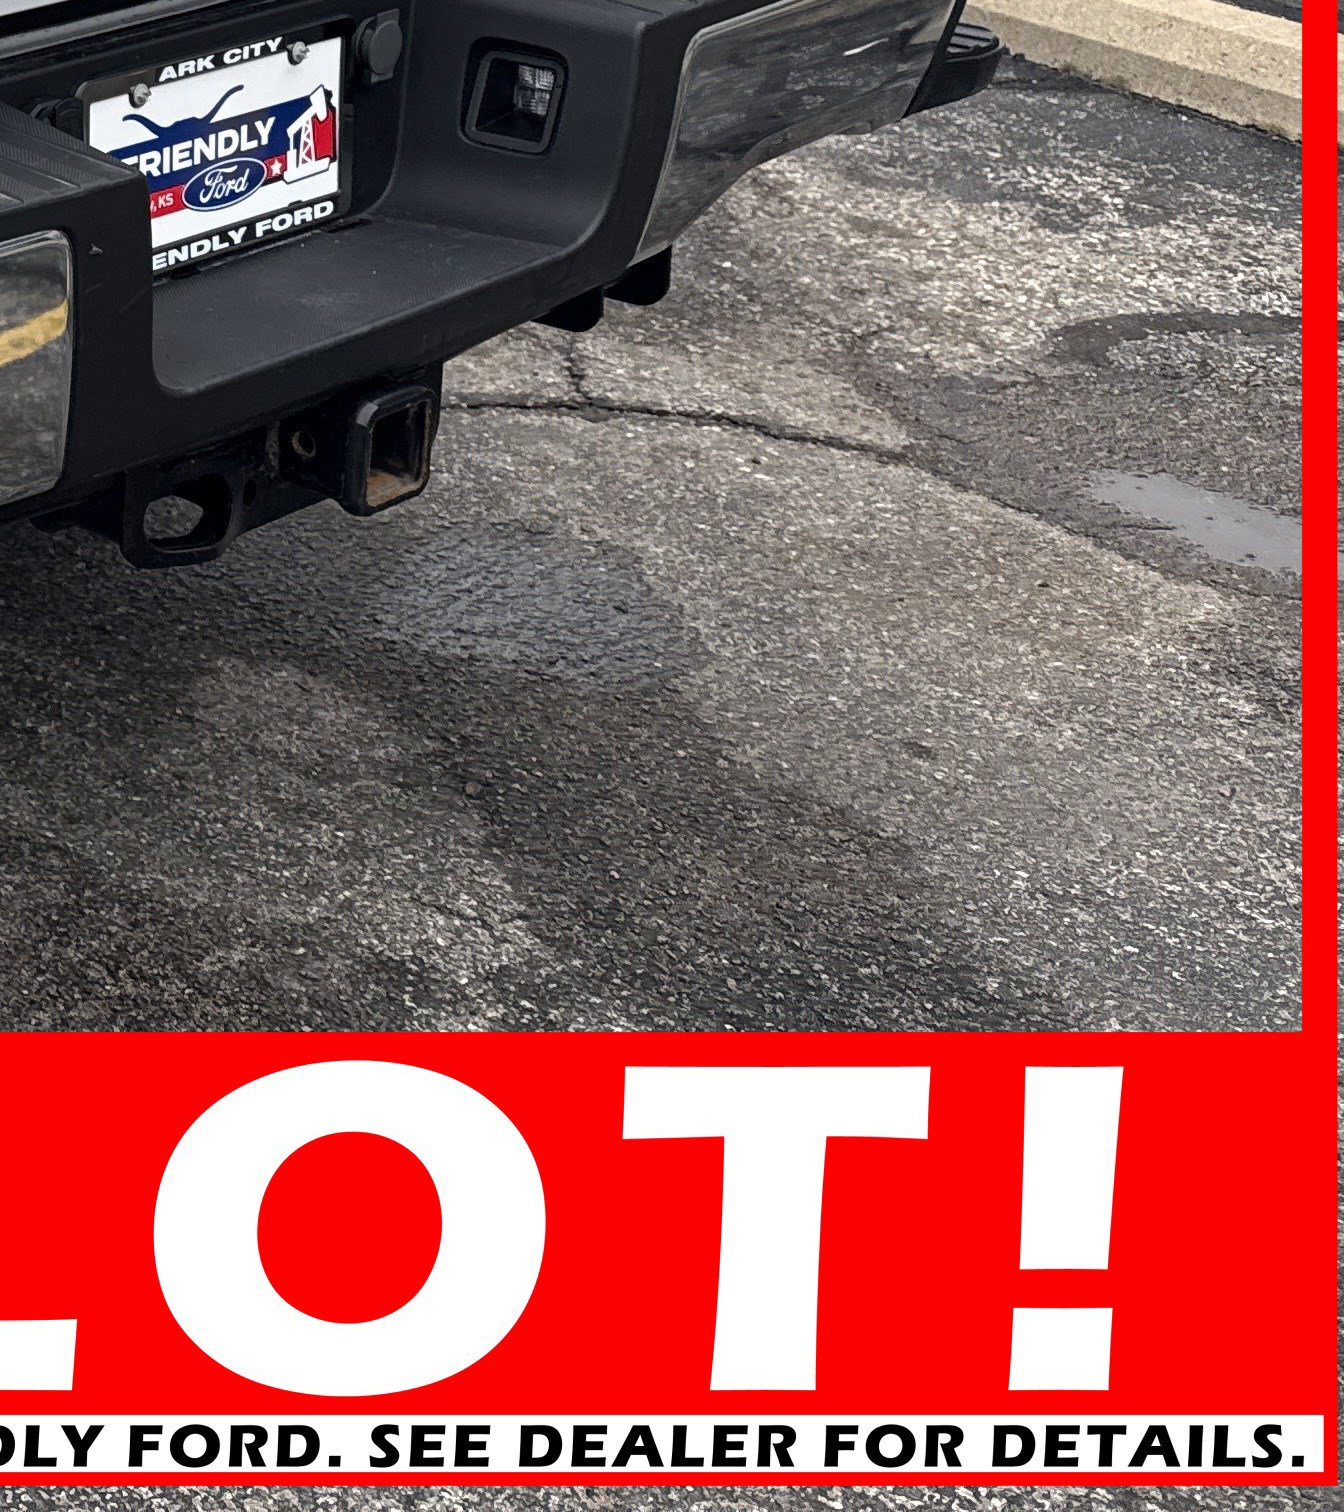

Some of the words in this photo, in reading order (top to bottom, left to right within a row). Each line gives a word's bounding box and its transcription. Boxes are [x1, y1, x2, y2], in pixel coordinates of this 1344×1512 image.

[158, 54, 216, 83] ARK
[223, 36, 284, 65] CITY
[158, 192, 175, 208] KS
[199, 166, 249, 204] Ford
[255, 200, 335, 238] FORD
